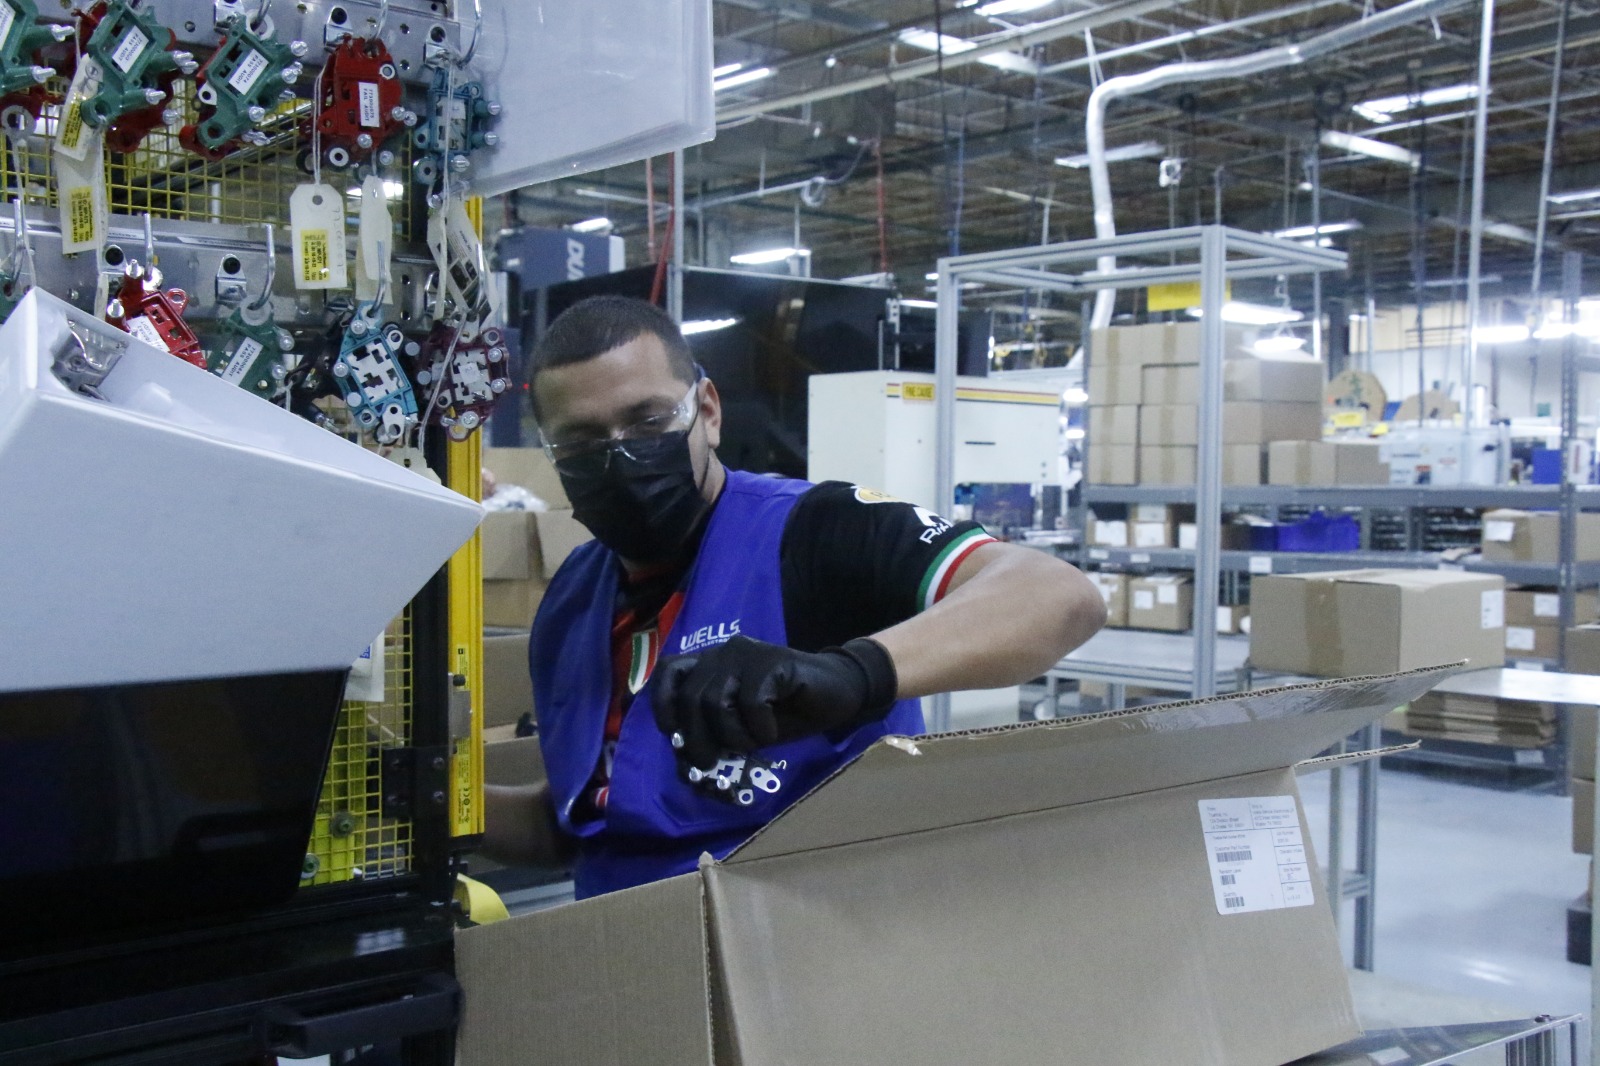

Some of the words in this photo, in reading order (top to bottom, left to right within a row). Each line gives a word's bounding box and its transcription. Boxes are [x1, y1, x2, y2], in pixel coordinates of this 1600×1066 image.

[239, 343, 251, 358] PASS
[228, 361, 239, 376] AUDIT
[680, 618, 740, 650] WELLS
